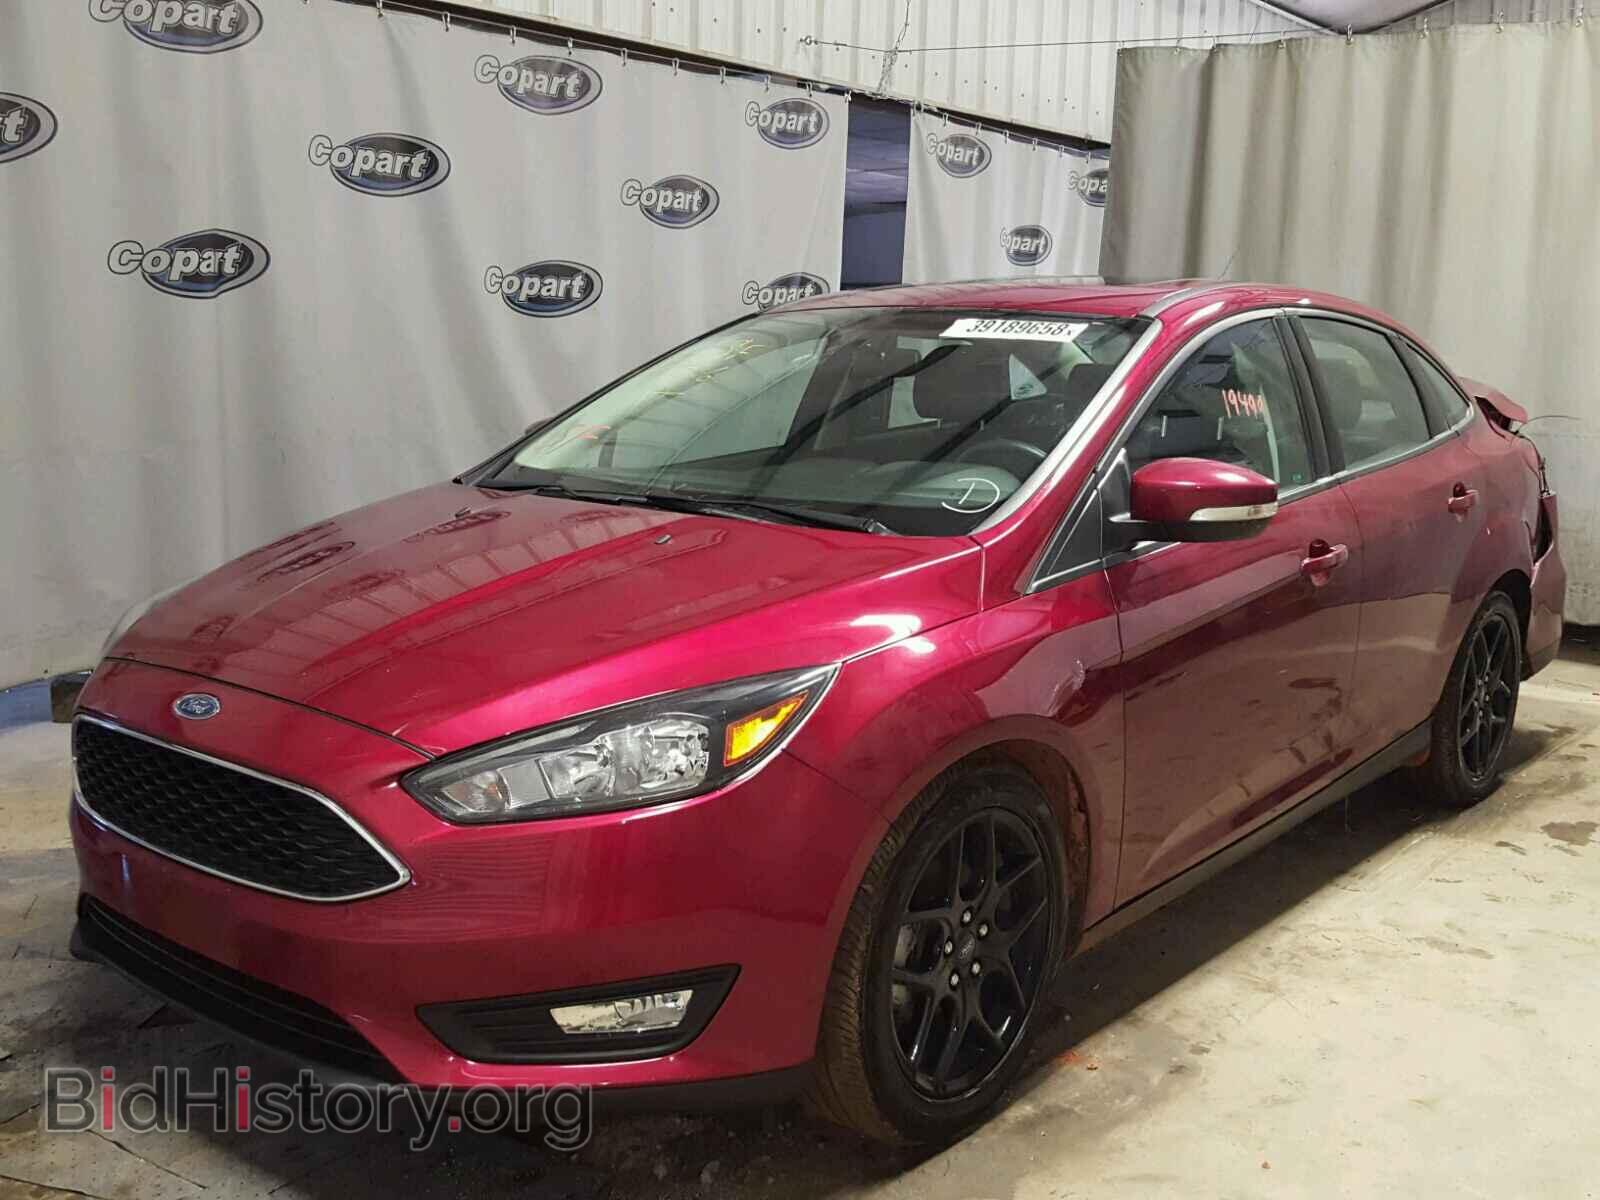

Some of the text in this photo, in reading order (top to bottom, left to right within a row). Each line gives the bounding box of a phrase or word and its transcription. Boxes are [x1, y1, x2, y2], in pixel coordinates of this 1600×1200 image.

[88, 0, 240, 35] Copart
[474, 55, 584, 98] Copart
[745, 101, 820, 134] Copart
[308, 134, 431, 179] Copart
[926, 132, 981, 167] Copart
[620, 179, 703, 215] Copart
[1067, 170, 1108, 196] Copa
[484, 265, 586, 304] Copart
[965, 320, 1069, 336] 39189658
